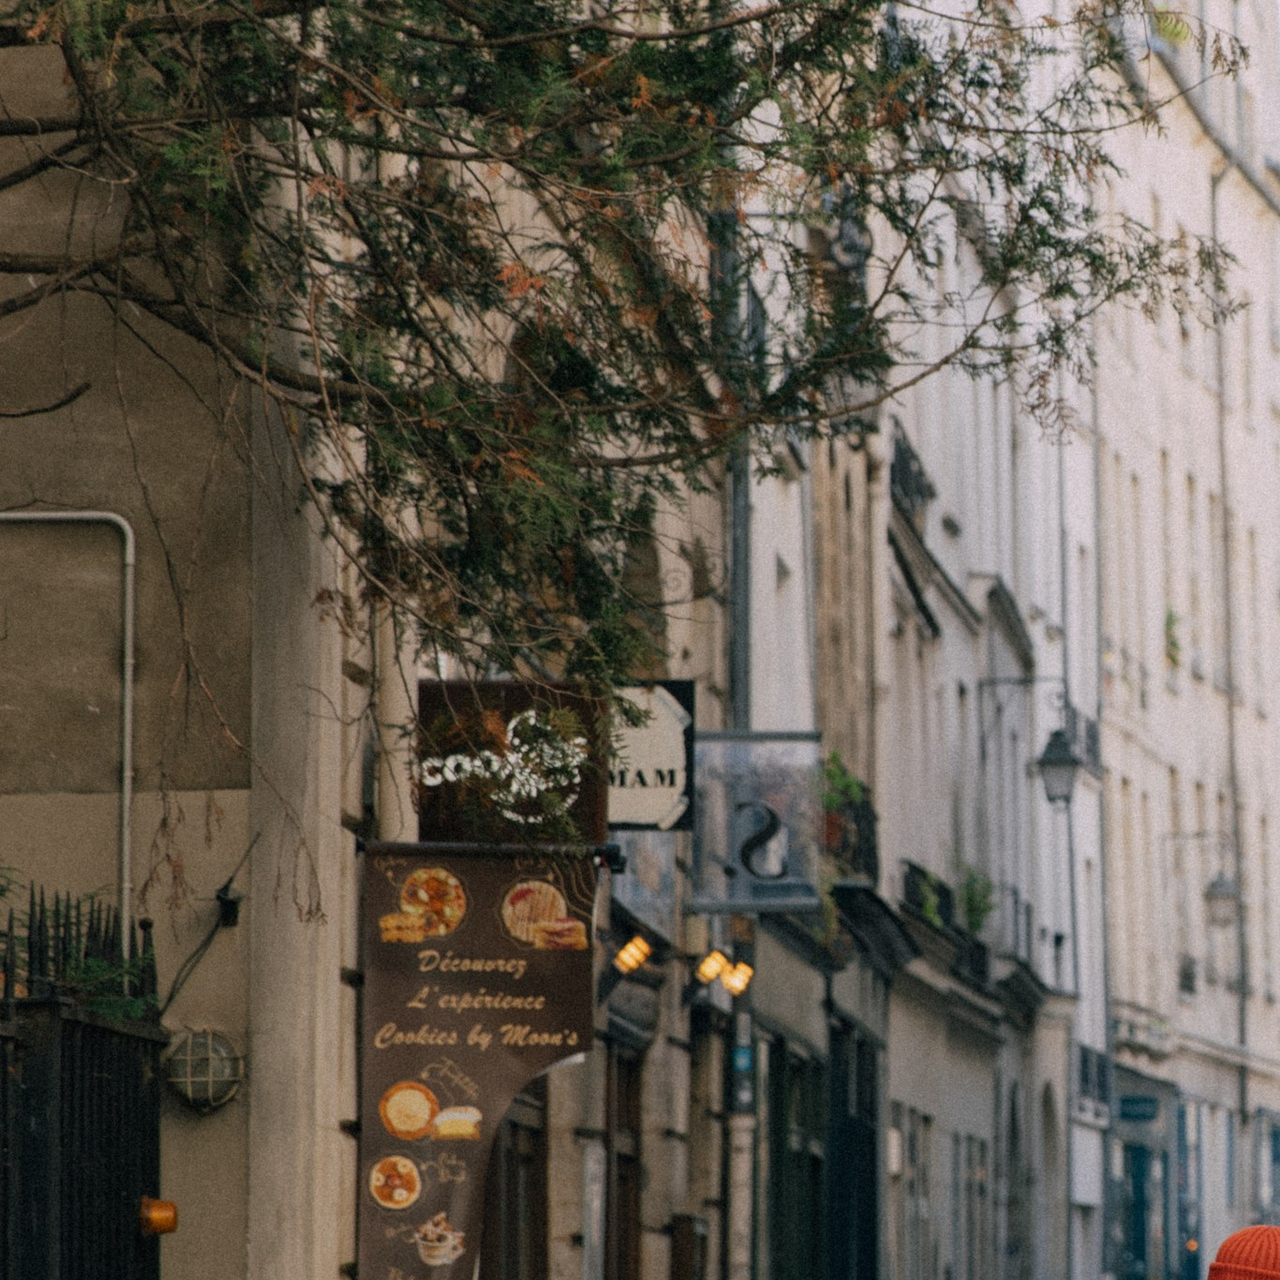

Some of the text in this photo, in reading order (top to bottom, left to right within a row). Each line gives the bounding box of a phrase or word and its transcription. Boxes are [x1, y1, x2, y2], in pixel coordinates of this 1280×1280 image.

[417, 949, 527, 979] Découvrez
[406, 986, 546, 1014] L'expérience
[374, 1022, 579, 1051] Cookies by Moon's
